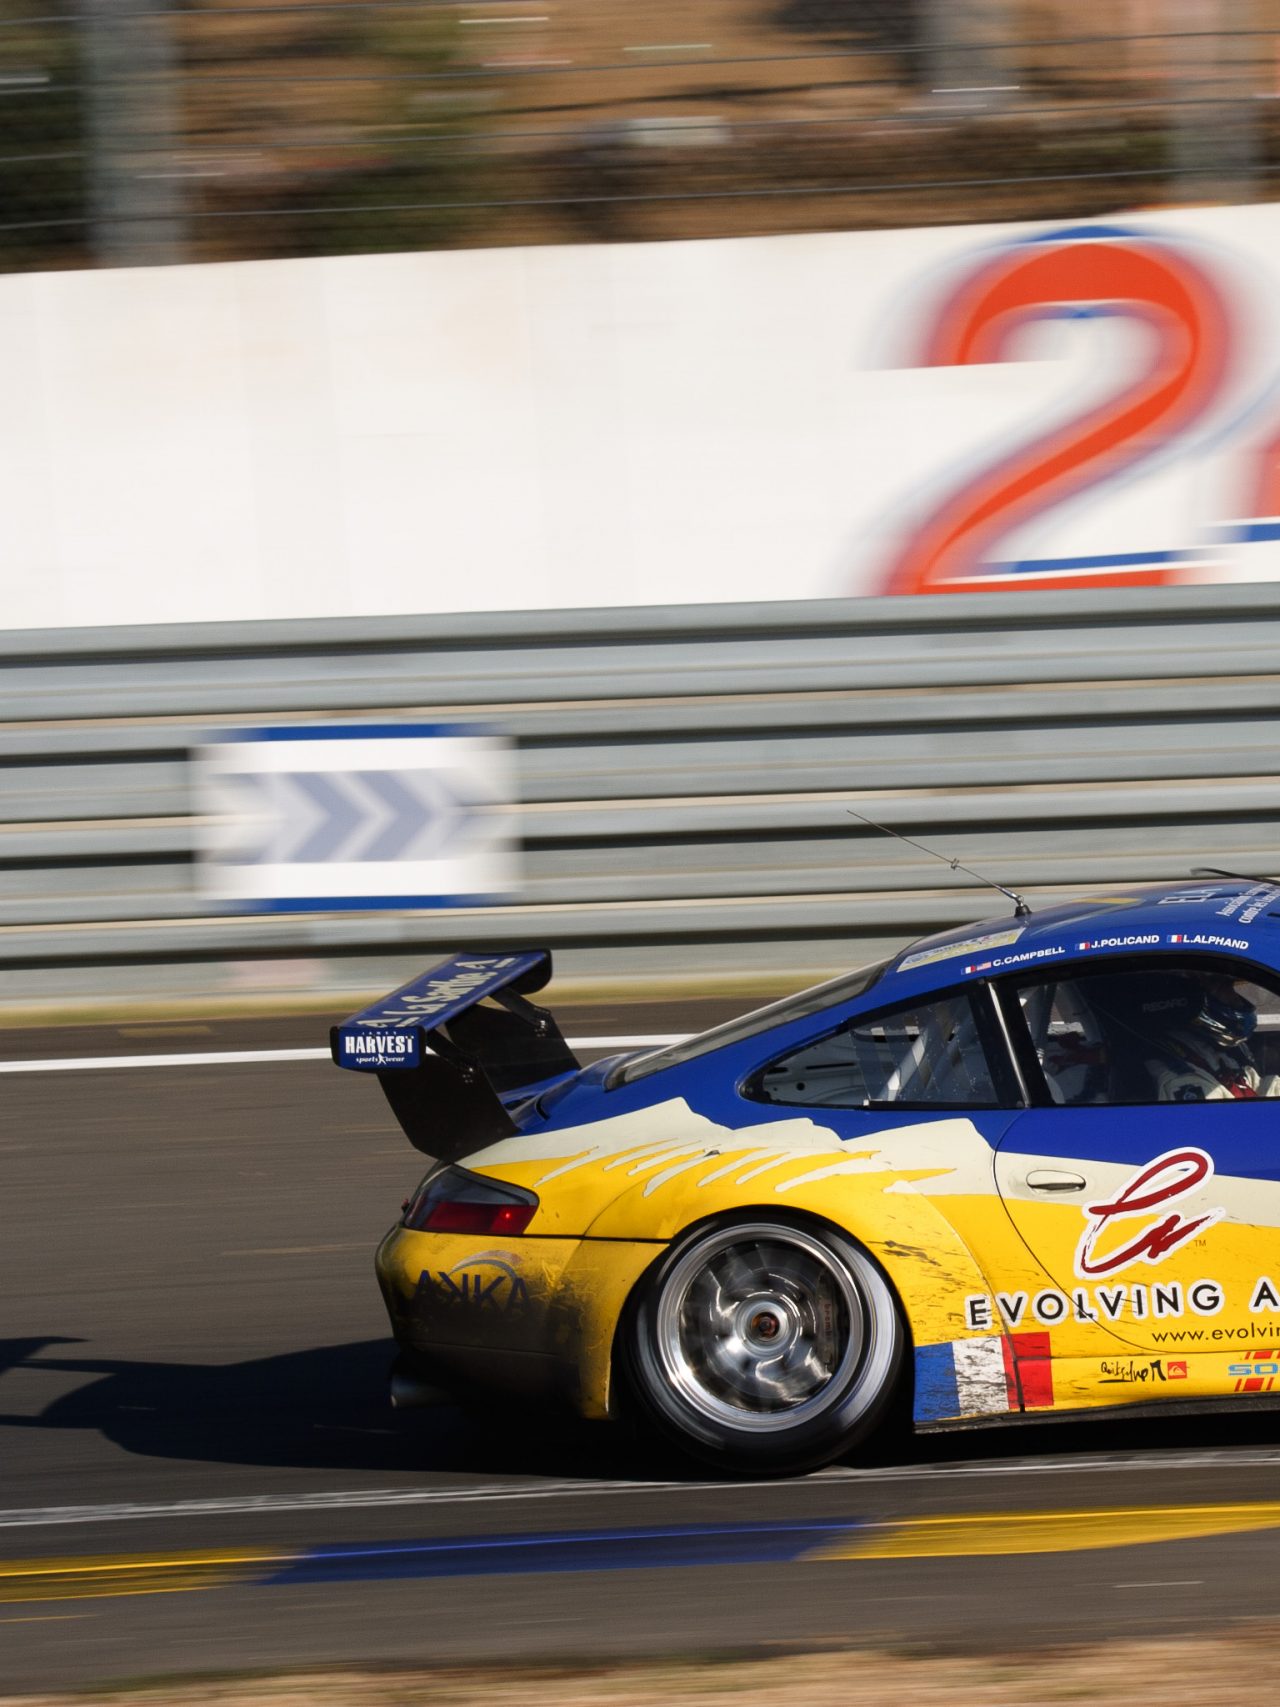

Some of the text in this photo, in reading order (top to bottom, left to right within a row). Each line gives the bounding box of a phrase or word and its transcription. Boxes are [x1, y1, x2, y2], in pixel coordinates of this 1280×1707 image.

[1091, 935, 1160, 949] J.POLICAND
[1183, 934, 1249, 951] L.ALPHAND
[993, 946, 1065, 967] C.CAMPBELL
[345, 1035, 414, 1054] HARVEST
[968, 1283, 1220, 1327] EVOLVING
